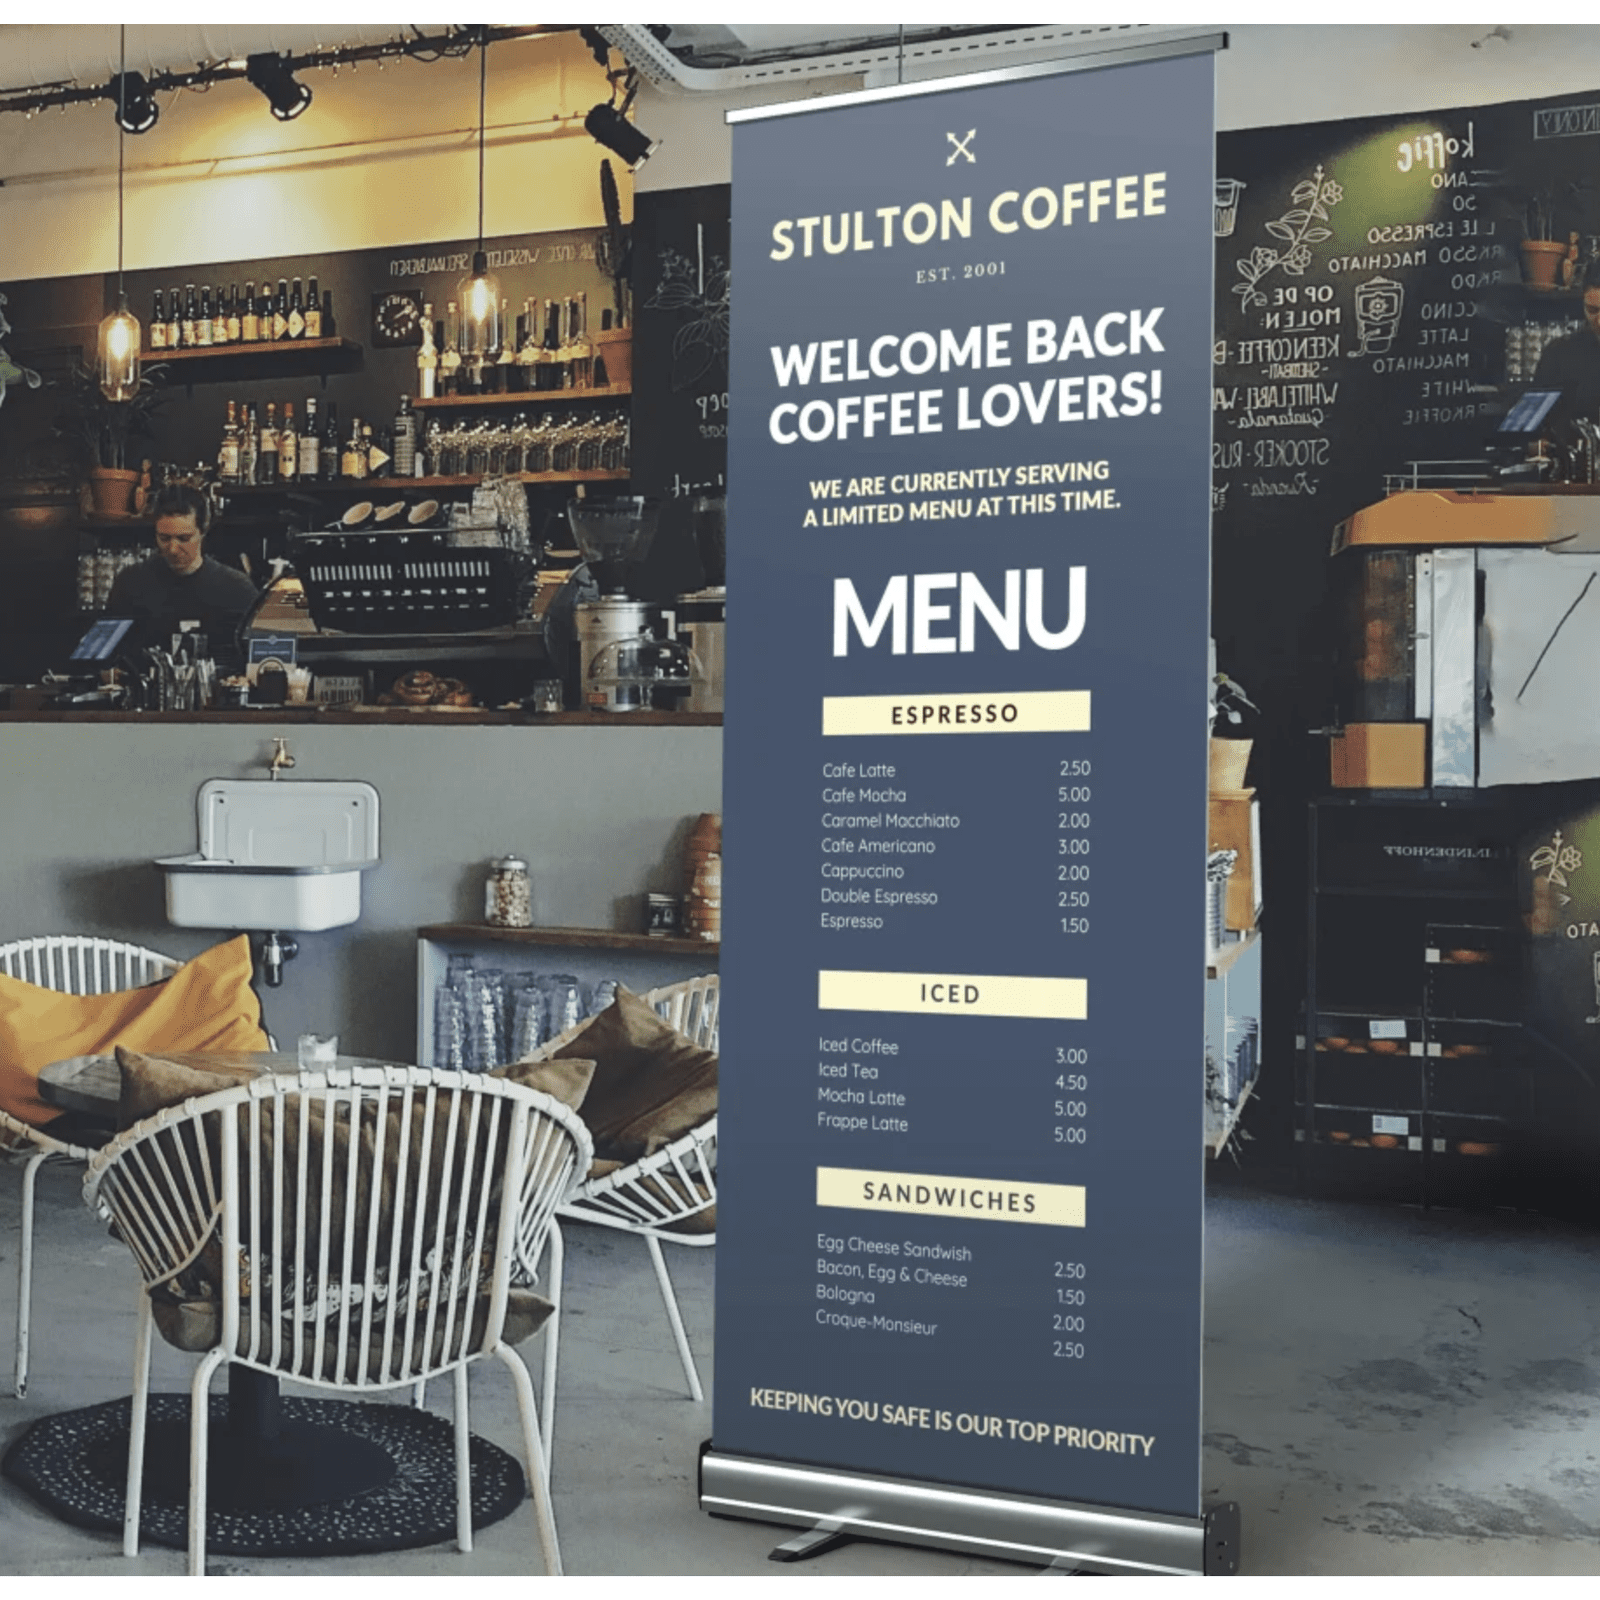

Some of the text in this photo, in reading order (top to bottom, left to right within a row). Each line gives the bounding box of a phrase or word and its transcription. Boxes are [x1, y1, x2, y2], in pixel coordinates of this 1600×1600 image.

[770, 172, 1167, 261] STULTON COFFEE
[916, 261, 1006, 284] EST. 2001
[770, 307, 1166, 388] WELCOME BACK
[769, 370, 1162, 445] COFFEE LOVERS!
[810, 461, 1110, 500] WE ARE CURRENTLY SERVING
[802, 489, 1121, 528] A LIMITED MENU AT THIS TIME.
[834, 566, 1087, 658] MENU
[892, 704, 1018, 726] ESPRESSO
[823, 763, 896, 778] Cafe Latte
[1060, 760, 1092, 777] 2.50
[822, 787, 907, 804] Cafe Mocha
[1059, 787, 1092, 803] 5.00
[822, 813, 961, 829] Caramel Macchiato
[1059, 813, 1091, 829] 2.00
[822, 838, 936, 854] Cafe Americano
[1059, 839, 1090, 855] 3.00
[822, 863, 905, 881] Cappuccino
[1059, 865, 1090, 881] 2.00
[821, 888, 939, 907] Double Espresso
[1059, 892, 1090, 908] 2.50
[821, 913, 884, 931] Espresso
[1061, 918, 1090, 934] 1.50
[922, 984, 980, 1004] ICED
[820, 1037, 900, 1056] Iced Coffee
[1057, 1048, 1088, 1065] 3.00
[819, 1062, 879, 1080] Iced Tea
[1056, 1075, 1088, 1092] 4.50
[818, 1087, 907, 1107] Mocha Latte
[1055, 1100, 1087, 1118] 5.00
[818, 1112, 909, 1133] Frappe Latte
[1055, 1127, 1087, 1145] 5.00
[862, 1181, 1038, 1215] SANDWICHES
[818, 1234, 972, 1262] Egg Cheese Sandwish
[817, 1258, 968, 1288] Bacon, Egg & Cheese
[1055, 1262, 1086, 1280] 2.50
[816, 1284, 876, 1306] Bologna
[1057, 1289, 1086, 1307] 1.50
[816, 1309, 938, 1336] Croque-Monsieur
[1053, 1314, 1085, 1333] 2.00
[1054, 1341, 1085, 1359] 2.50
[751, 1387, 1156, 1457] KEEPING YOU SAFE IS OUR TOP PRIORITY
